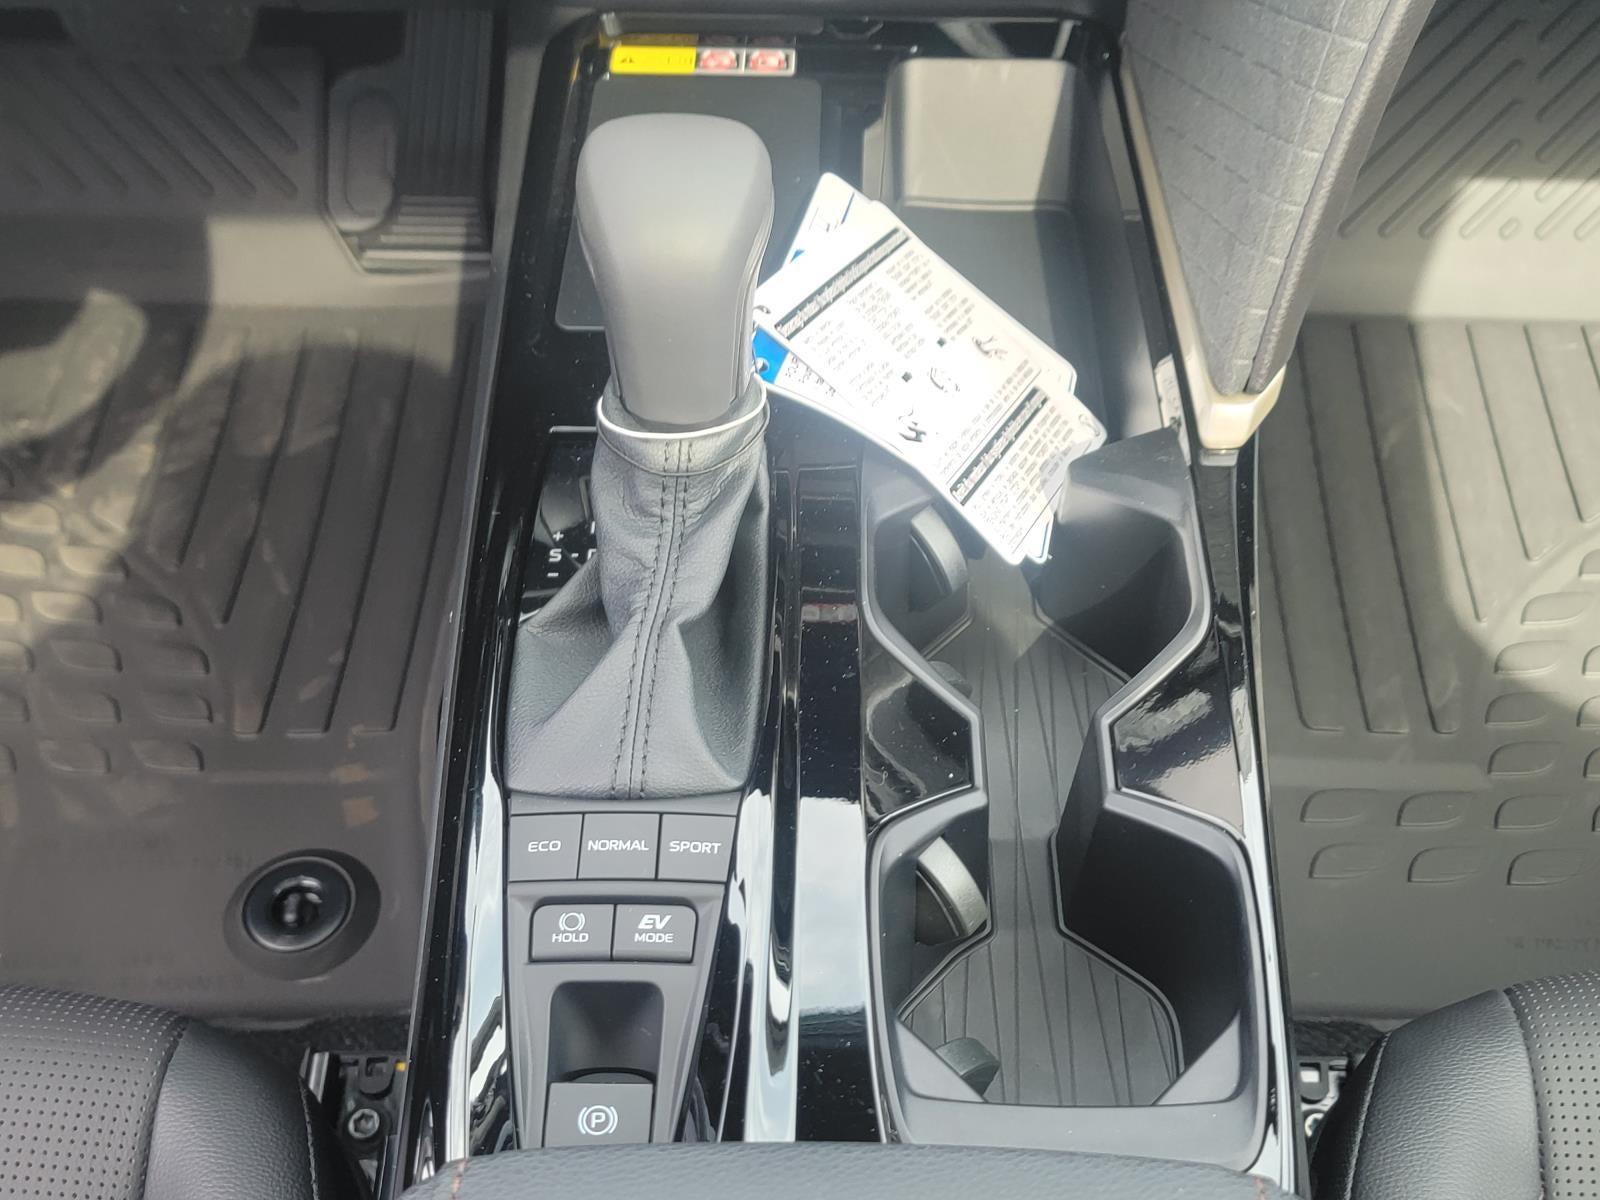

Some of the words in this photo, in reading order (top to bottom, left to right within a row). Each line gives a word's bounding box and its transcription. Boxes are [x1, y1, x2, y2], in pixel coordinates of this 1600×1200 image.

[549, 549, 562, 562] S
[527, 840, 562, 853] ECO
[587, 839, 650, 851] NORMAL
[669, 840, 722, 854] SPORT
[637, 914, 673, 930] EV
[551, 932, 589, 943] HOLD
[634, 932, 674, 943] MODE
[590, 1112, 607, 1128] P
